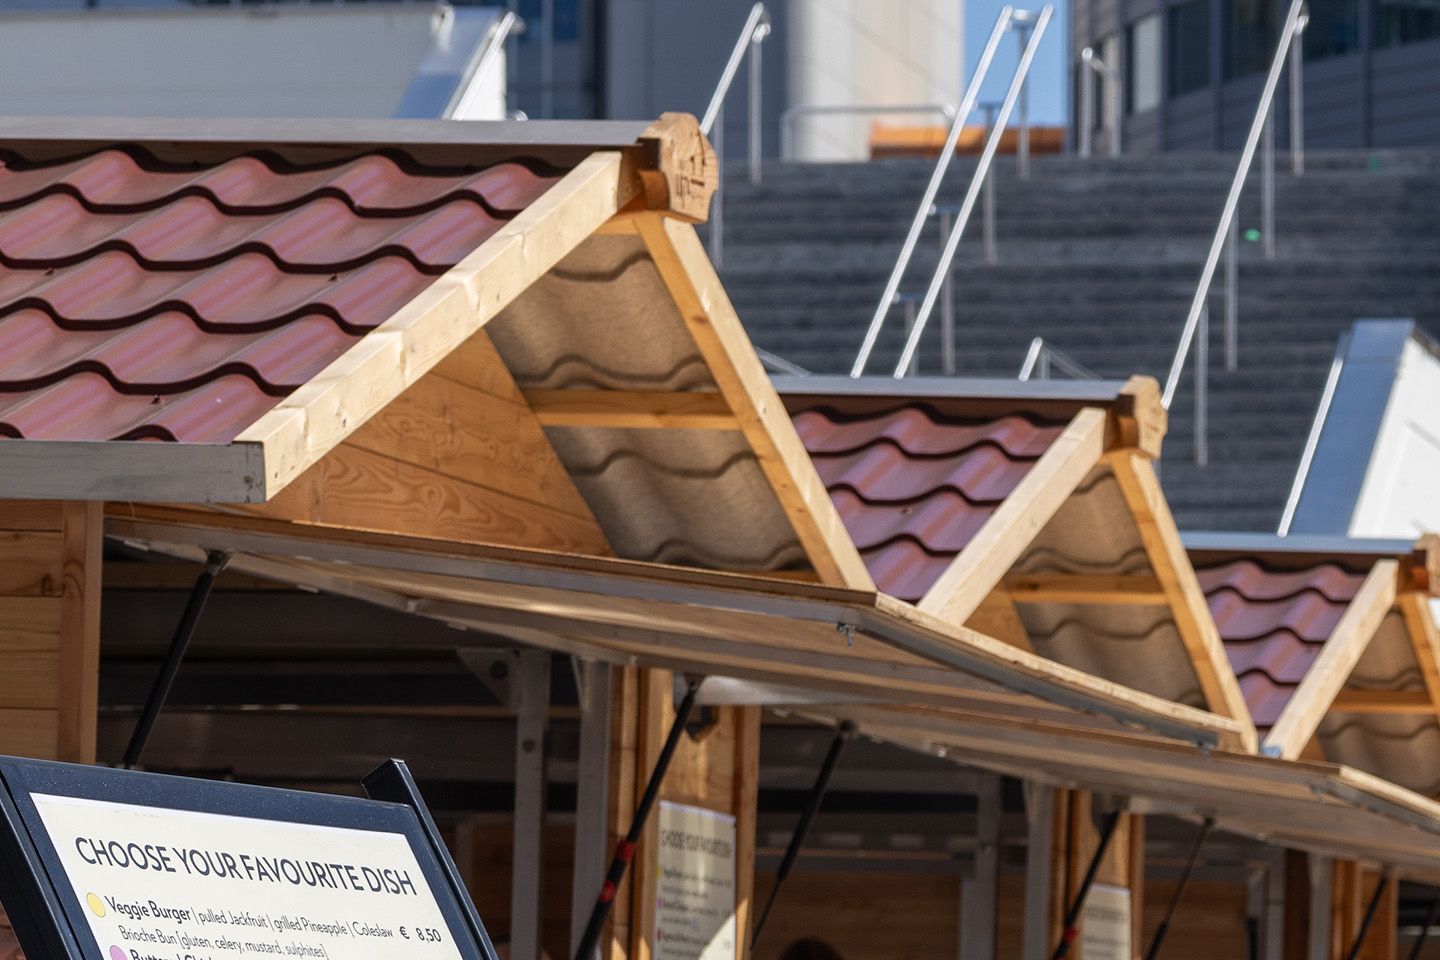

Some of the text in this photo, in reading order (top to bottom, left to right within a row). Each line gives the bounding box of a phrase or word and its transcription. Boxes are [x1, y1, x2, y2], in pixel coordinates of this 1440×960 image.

[75, 837, 418, 896] CHOOSE YOUR FAVOURITE DISH
[104, 895, 442, 943] Veggie Burger pulled Jackfruit grilled Pineapple Coleslaw € 8,50
[118, 924, 156, 943] Brioche
[155, 928, 178, 945] Bun
[175, 931, 214, 950] [gluten,
[214, 935, 245, 954] celery,
[244, 941, 284, 955] mustard,
